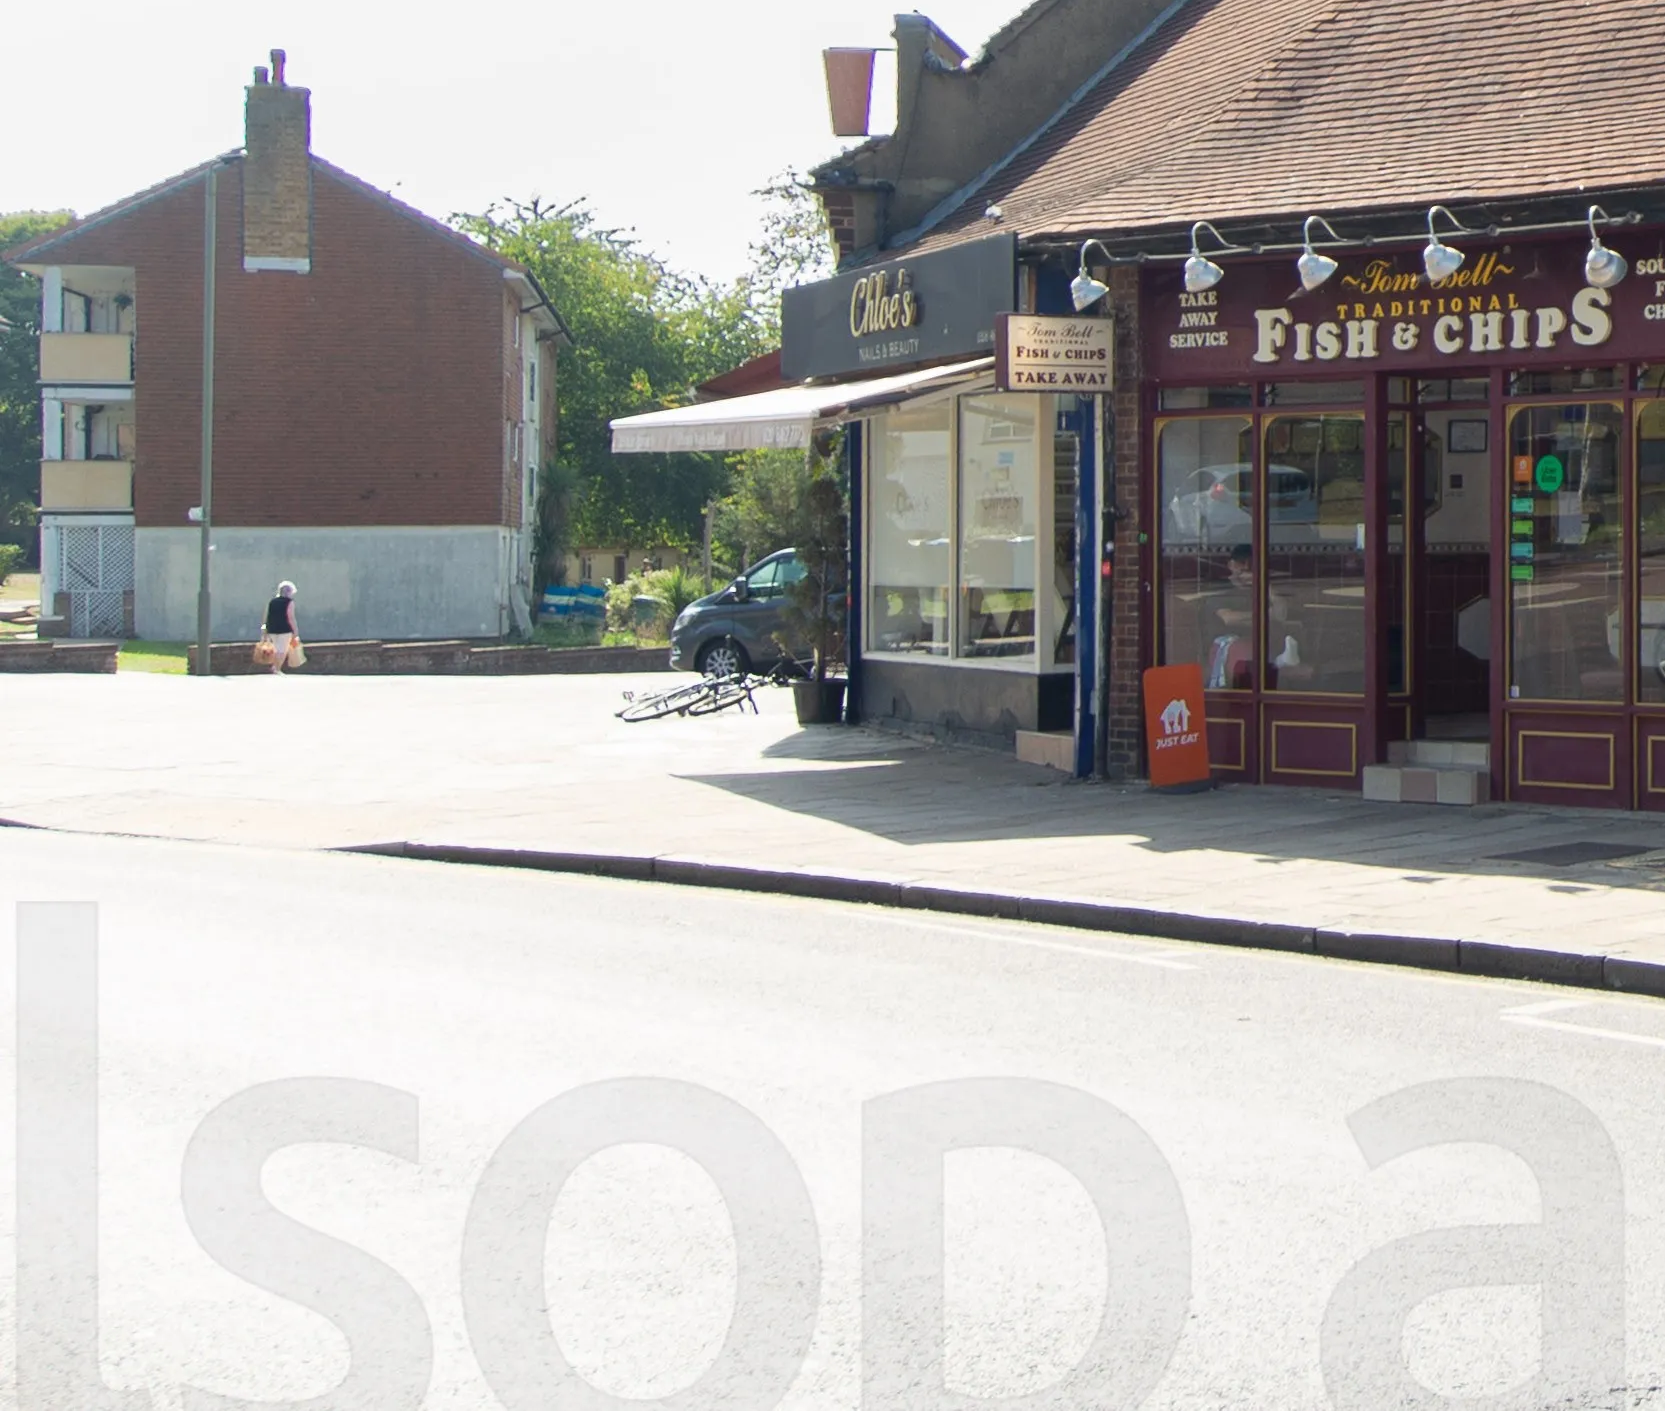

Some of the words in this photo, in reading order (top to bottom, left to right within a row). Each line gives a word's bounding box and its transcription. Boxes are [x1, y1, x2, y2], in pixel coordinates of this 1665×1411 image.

[1361, 260, 1420, 294] Tom
[851, 268, 917, 337] Chloe's
[1179, 291, 1218, 307] TAKE
[1337, 293, 1519, 320] TRADITIONAL
[1179, 311, 1218, 327] AWAY
[1252, 307, 1379, 363] FISH
[1392, 321, 1420, 351] &
[1434, 287, 1613, 354] CHIPS
[1027, 322, 1056, 337] Tom
[1061, 323, 1094, 338] Bell
[1169, 330, 1228, 348] SERVICE
[859, 344, 881, 362] NAILS
[882, 342, 887, 358] &
[889, 339, 919, 357] BEAUTY
[1016, 346, 1049, 358] FISH
[1065, 348, 1106, 360] CHIPS
[1015, 371, 1057, 383] TAKE
[1062, 372, 1107, 385] AWAY
[1156, 736, 1179, 750] JUST
[1180, 732, 1199, 744] EAT
